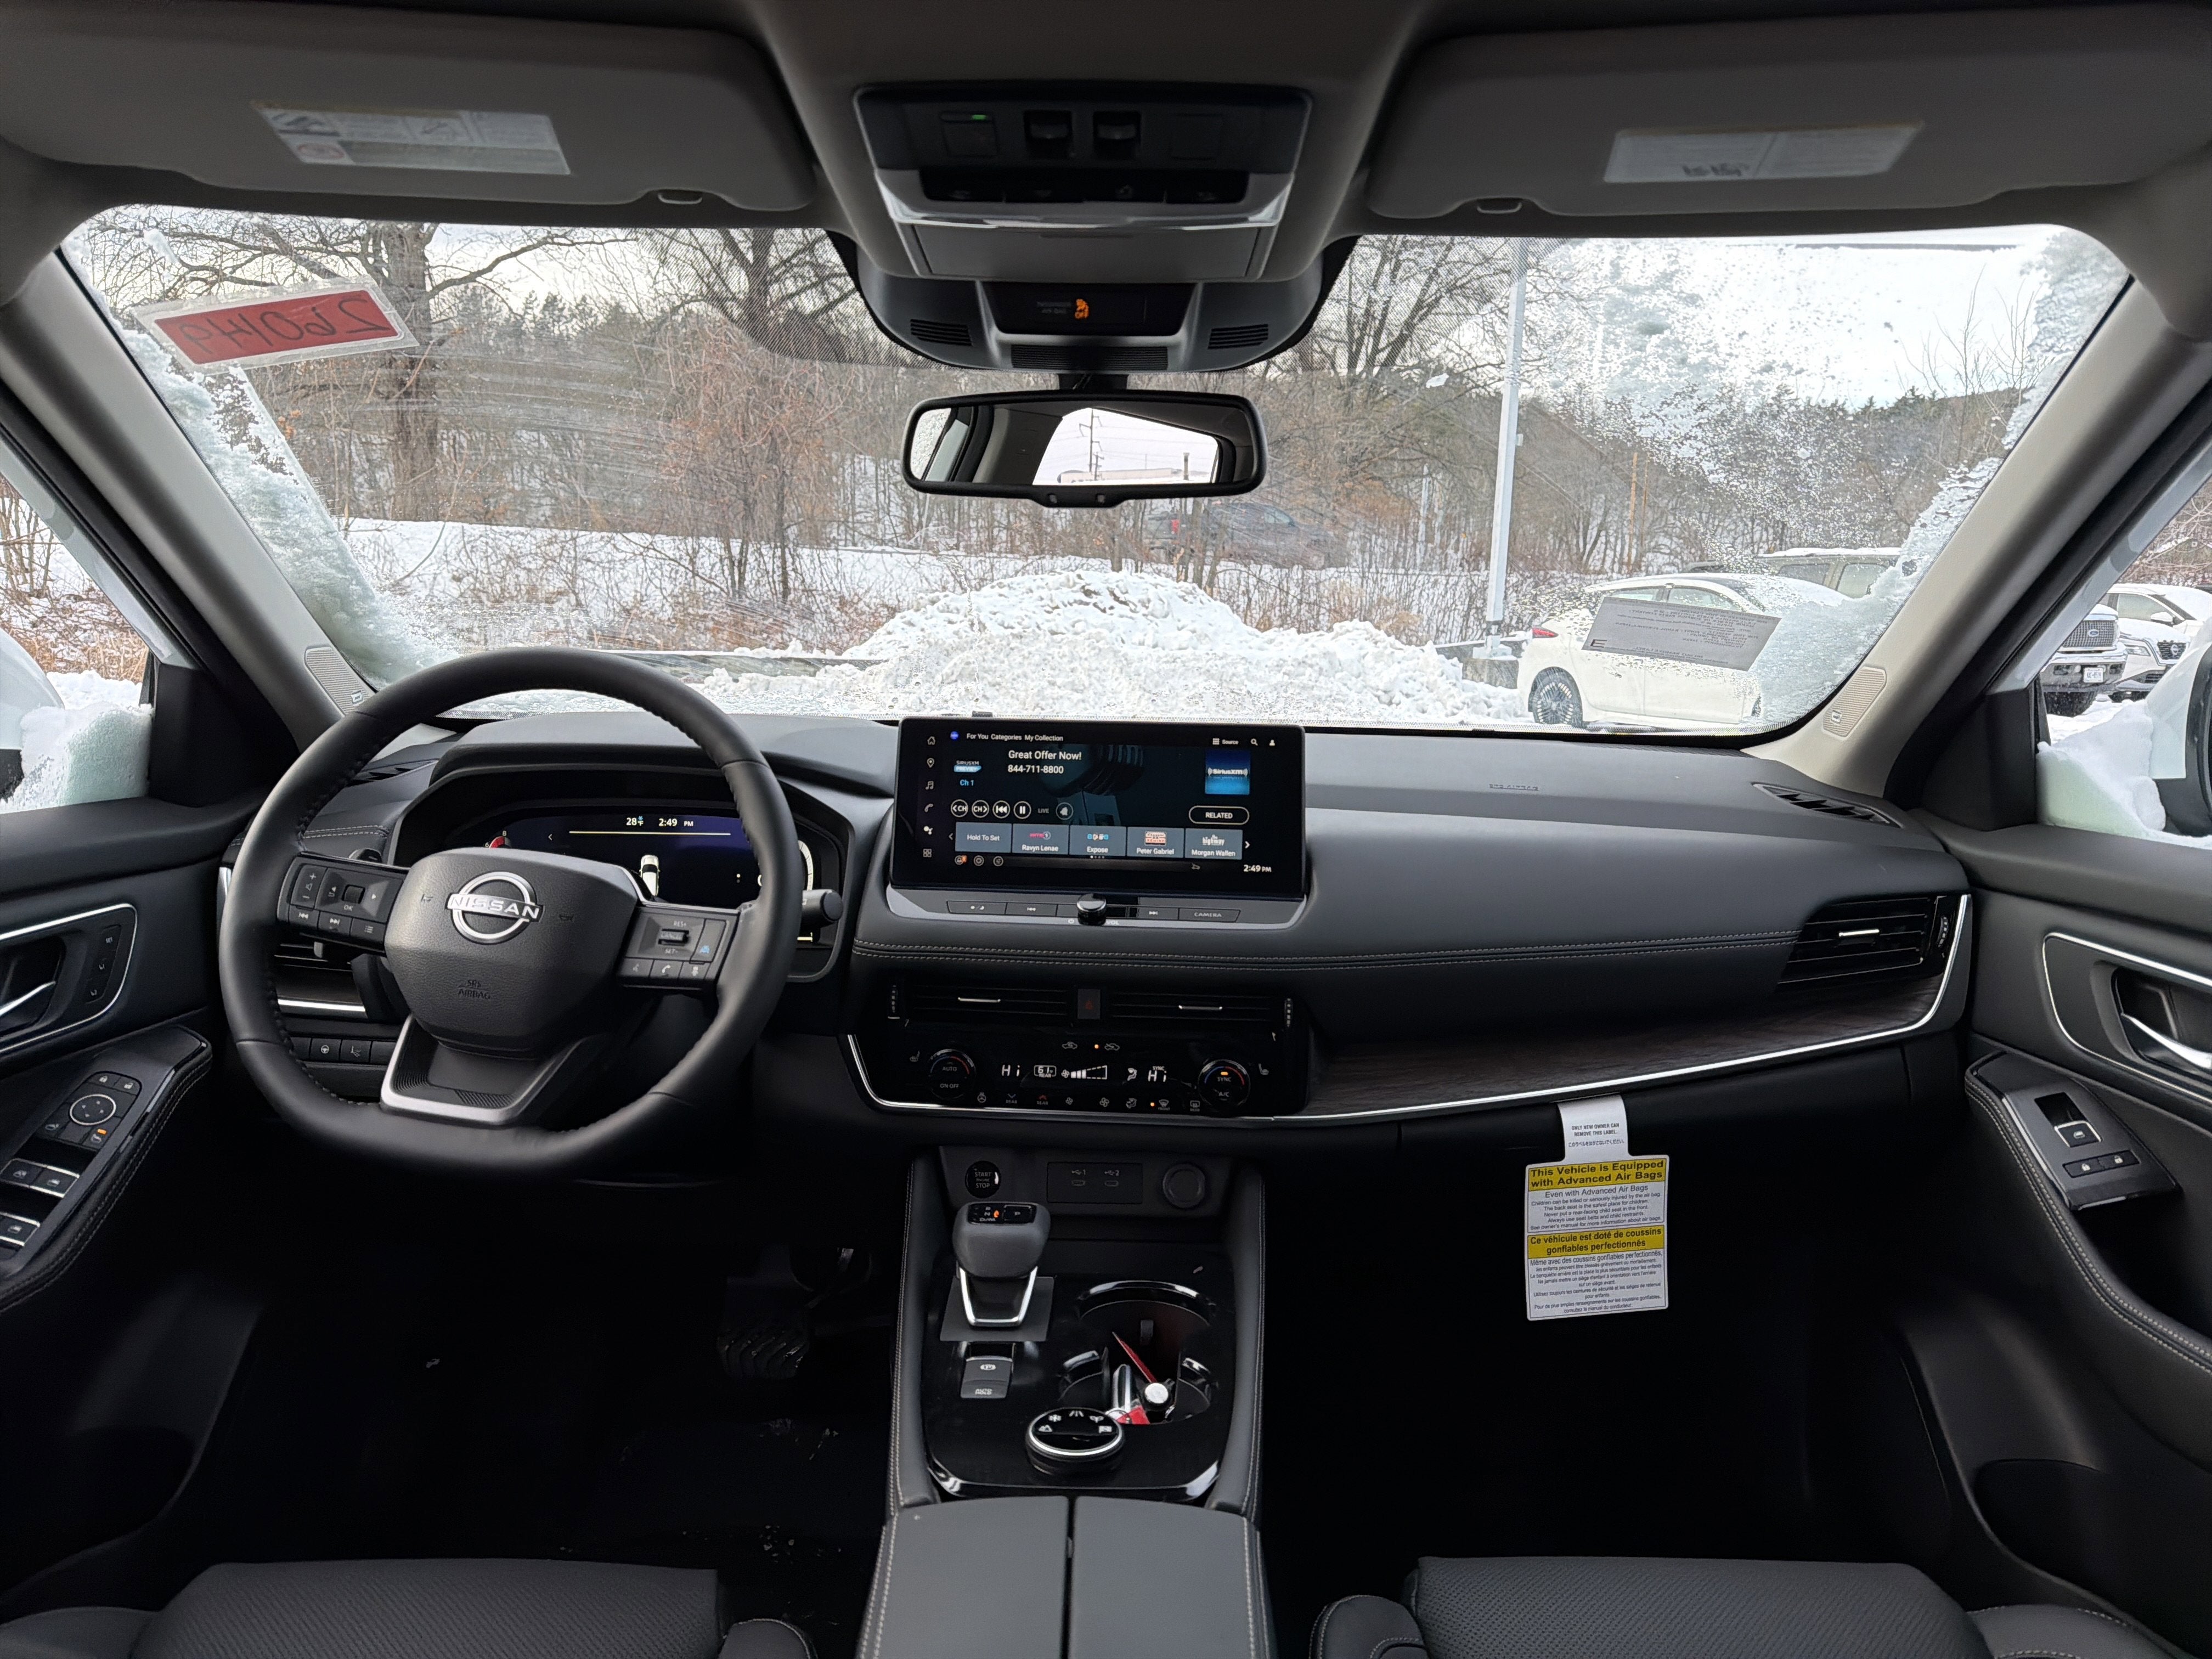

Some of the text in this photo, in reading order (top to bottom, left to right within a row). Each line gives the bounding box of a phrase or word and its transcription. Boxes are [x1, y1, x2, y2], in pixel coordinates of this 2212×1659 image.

[1008, 751, 1082, 760] Great Offer Now!
[1008, 765, 1064, 774] 844-711-8800
[1192, 849, 1214, 857] Morgan
[1244, 864, 1261, 872] 2:49
[451, 896, 539, 919] NISSAN
[1531, 1168, 1553, 1177] This
[1556, 1165, 1596, 1174] Vehicle
[1612, 1160, 1663, 1171] Equipped
[1531, 1171, 1662, 1187] with Advanced Air Bags
[1581, 1187, 1616, 1195] Advanced
[1543, 1234, 1577, 1243] véhicule
[1594, 1231, 1611, 1239] doté
[1626, 1228, 1661, 1237] coussins
[1547, 1239, 1645, 1255] gonflables perfectionnés
[1596, 1253, 1624, 1261] gonflables
